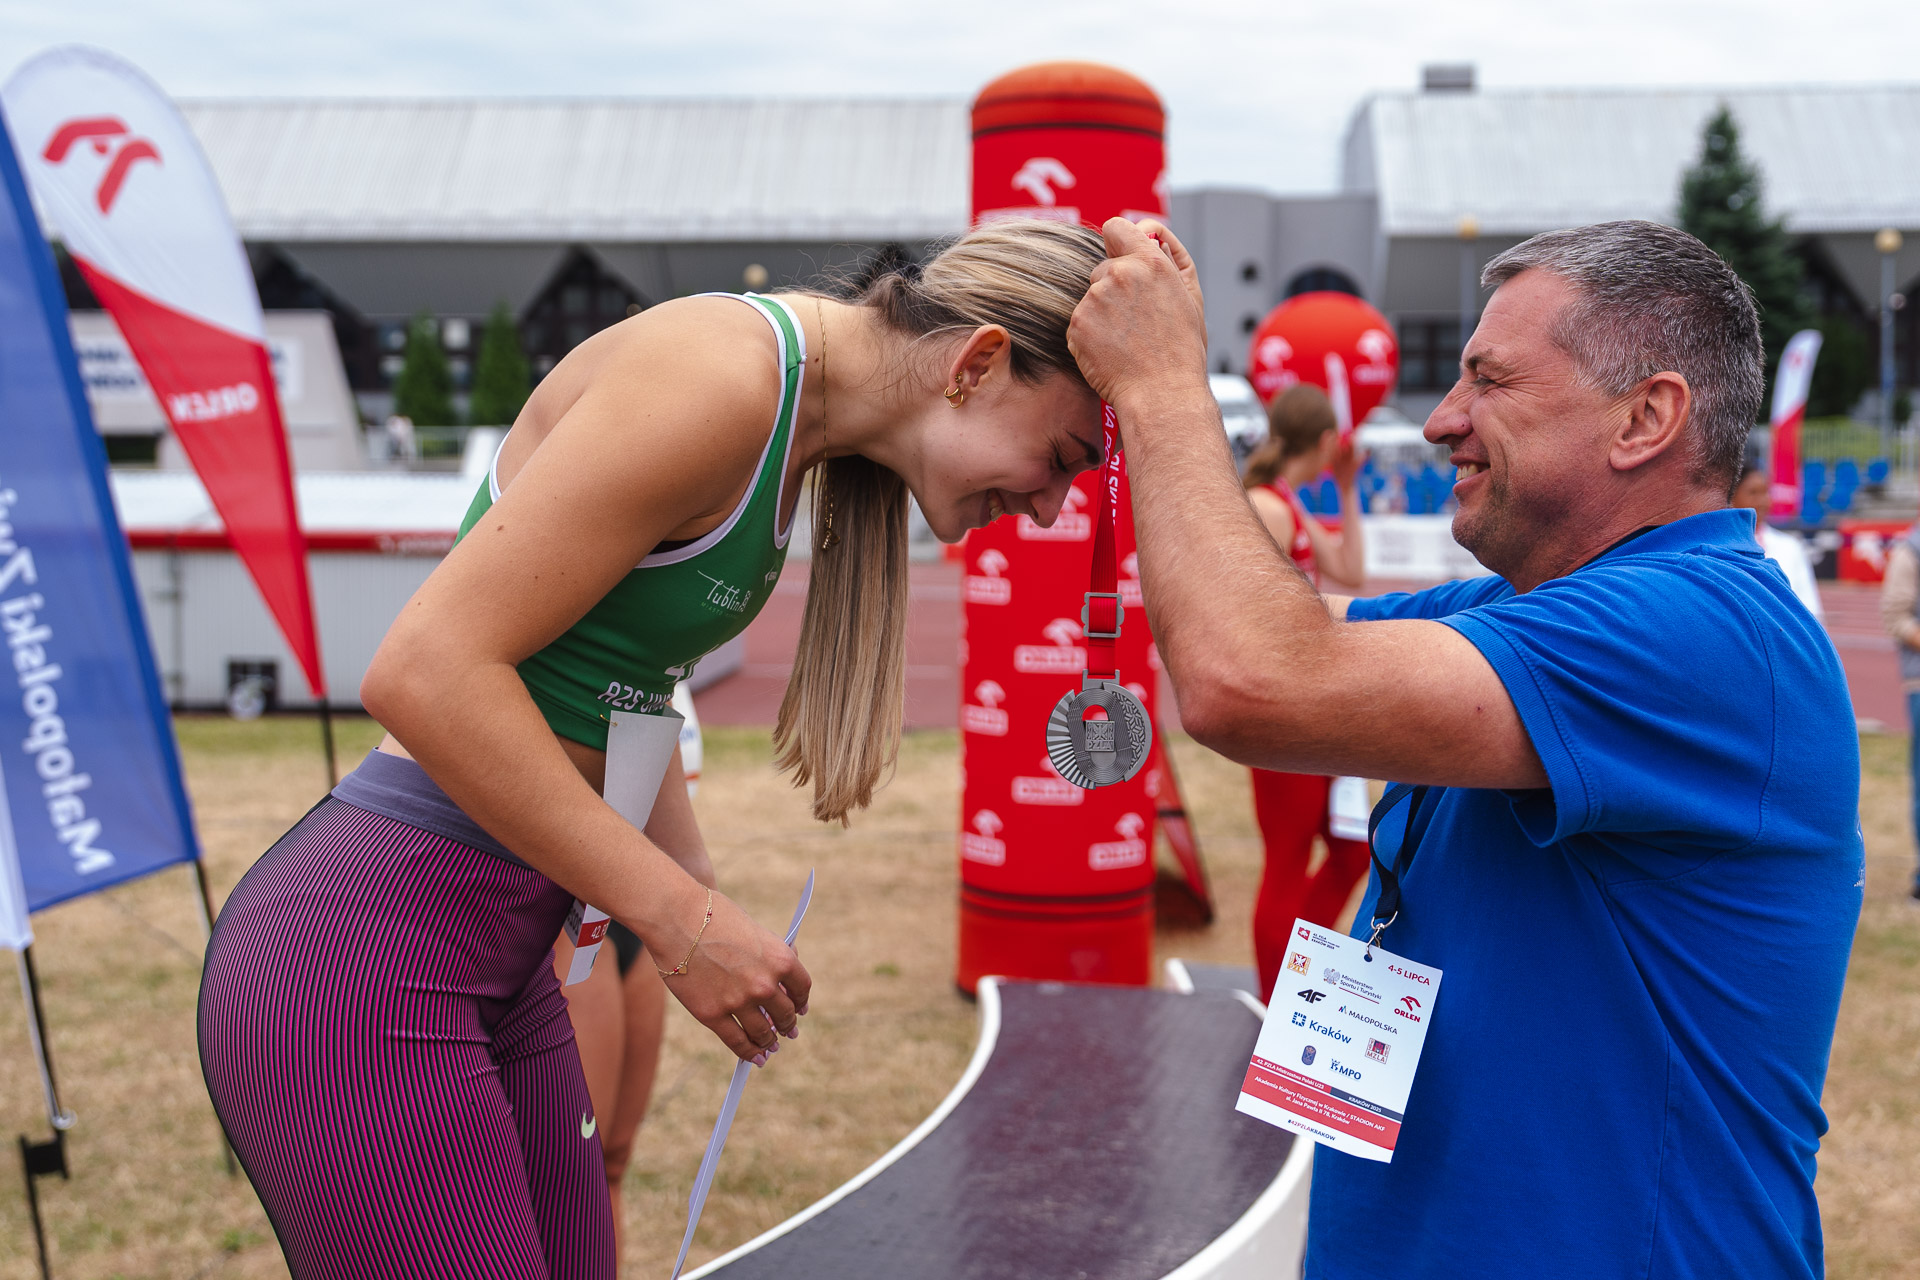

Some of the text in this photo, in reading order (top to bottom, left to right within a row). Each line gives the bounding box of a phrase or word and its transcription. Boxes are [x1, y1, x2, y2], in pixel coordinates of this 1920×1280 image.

[1341, 975, 1373, 990] Ministerstwo
[1388, 965, 1429, 985] 4-5 LIPCA
[1297, 988, 1326, 1004] 4F
[1340, 980, 1356, 989] Sportu
[1361, 988, 1381, 999] Turystyki
[1349, 1011, 1397, 1034] MAŁOPOLSKA
[1394, 1008, 1420, 1022] ORLEN
[1309, 1020, 1351, 1043] Kraków
[1367, 1051, 1384, 1062] MZLA
[1339, 1066, 1361, 1079] MPO
[1302, 1076, 1315, 1086] Polski
[1255, 1076, 1278, 1089] Akademia
[1279, 1086, 1296, 1097] Kultury
[1296, 1093, 1318, 1106] Fizycznej
[1324, 1104, 1346, 1116] Krakowie
[1350, 1115, 1374, 1127] STADION
[1292, 1098, 1303, 1106] Jana
